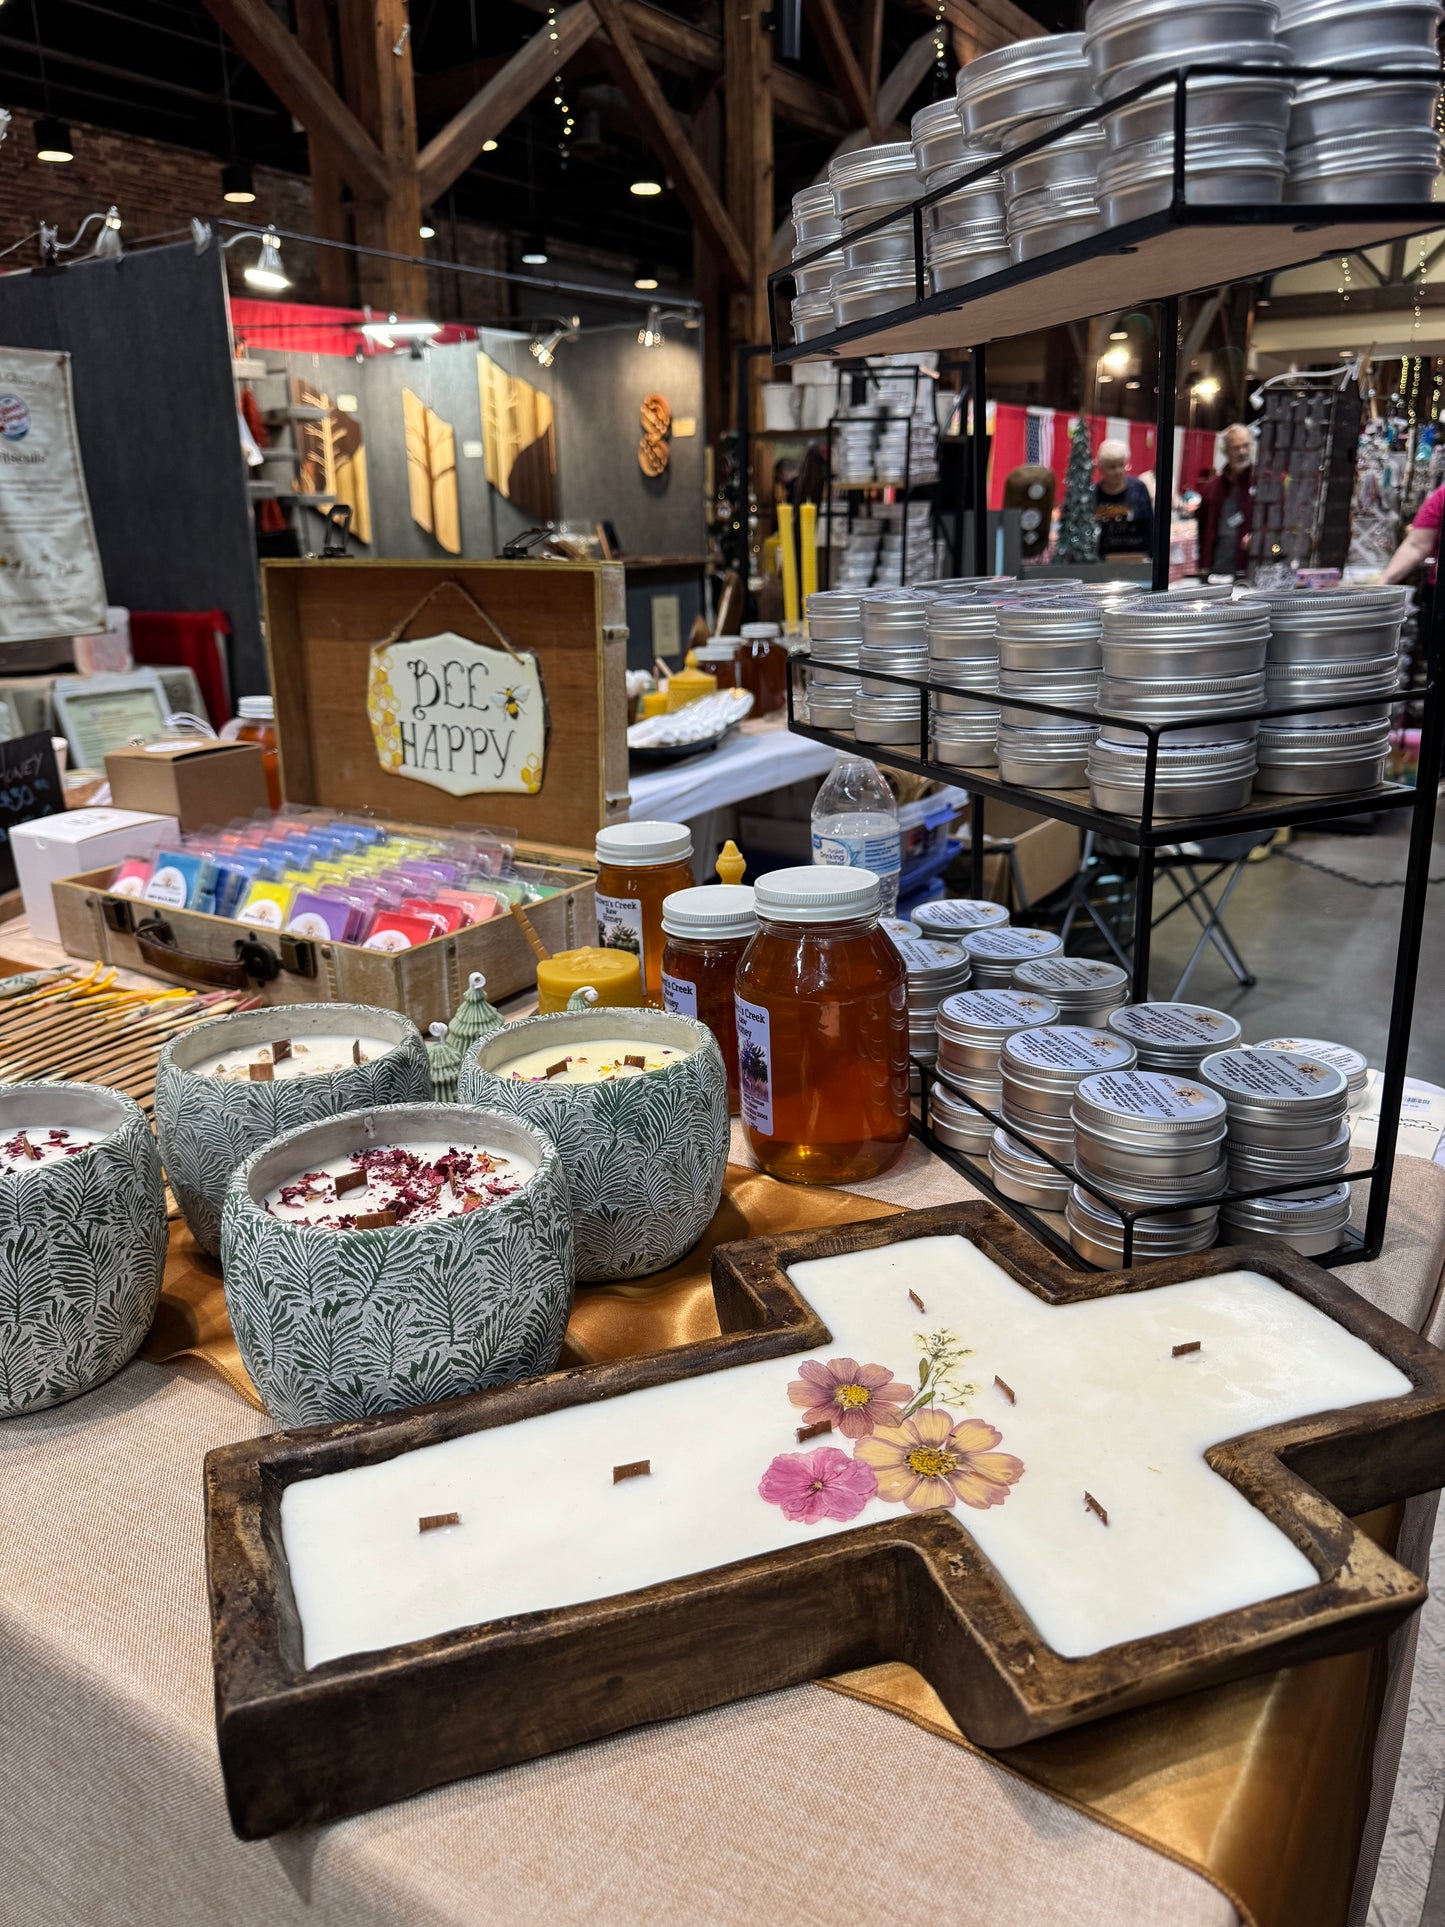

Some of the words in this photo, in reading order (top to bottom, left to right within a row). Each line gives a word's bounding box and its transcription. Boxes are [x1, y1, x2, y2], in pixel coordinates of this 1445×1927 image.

[407, 659, 490, 721] BEE
[398, 721, 516, 779] HAPPY
[606, 907, 617, 915] Raw
[615, 901, 637, 910] Creek
[602, 913, 623, 925] Honey
[671, 982, 693, 995] Creek
[745, 1008, 766, 1025] Creek
[1242, 1051, 1271, 1070] BEESWAX
[1269, 1070, 1295, 1086] LOTION
[1125, 1072, 1148, 1091] BEESWAX
[1144, 1091, 1166, 1108] LOTION
